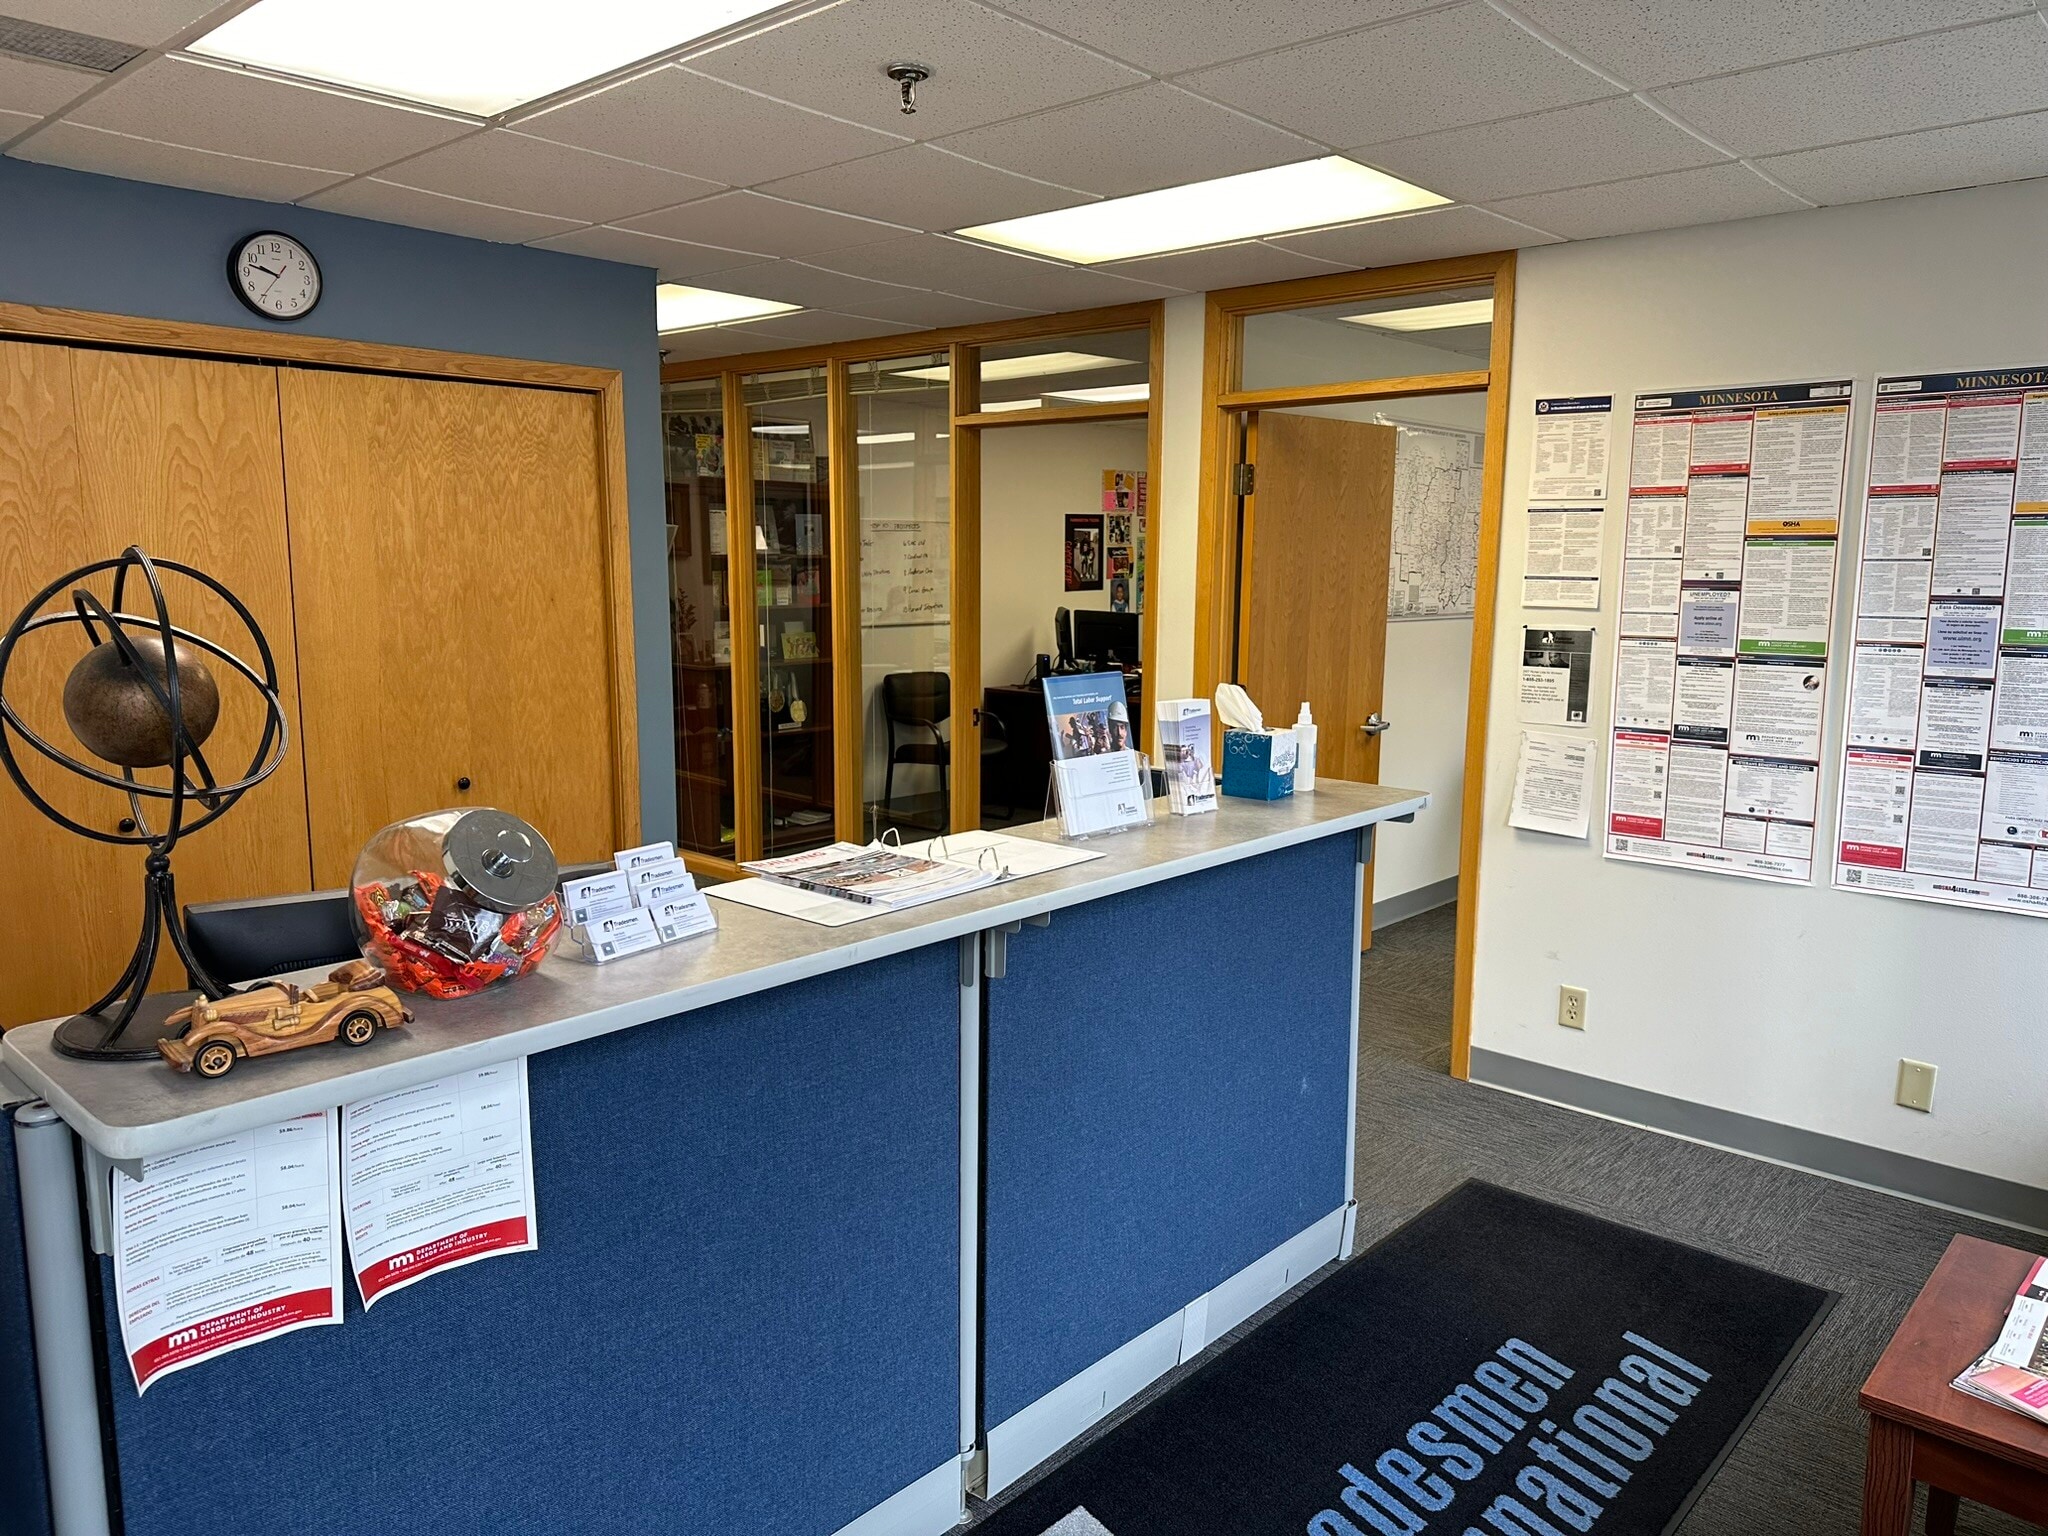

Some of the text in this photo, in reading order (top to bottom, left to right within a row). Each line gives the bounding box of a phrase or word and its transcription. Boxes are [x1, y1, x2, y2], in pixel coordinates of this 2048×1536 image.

[257, 244, 265, 255] 11
[270, 242, 281, 253] 12
[247, 253, 257, 263] 10
[289, 249, 293, 259] 1
[299, 261, 305, 271] 2
[243, 267, 250, 277] 9
[304, 275, 310, 285] 3
[248, 281, 255, 291] 8
[300, 289, 306, 298] 4
[261, 294, 267, 304] 7
[291, 298, 297, 307] 5
[276, 300, 282, 310] 6
[1956, 372, 2048, 389] MINNESOTA
[1699, 390, 1779, 406] MINNESOTA
[1072, 696, 1082, 705] Total
[1083, 695, 1095, 704] Labor
[1095, 694, 1112, 703] Support
[591, 884, 616, 894] Tradesmen
[674, 902, 697, 912] Tradesmen
[613, 916, 639, 927] Tradesmen
[416, 1235, 458, 1255] DEPARTMENT
[416, 1232, 488, 1262] LABOR AND INDUSTRY
[127, 1276, 160, 1294] HORAS EXTRAS
[200, 1306, 264, 1330] DEPARTMENT OF
[200, 1304, 286, 1337] LABOR AND INDUSTRY
[1463, 1329, 1713, 1536] national
